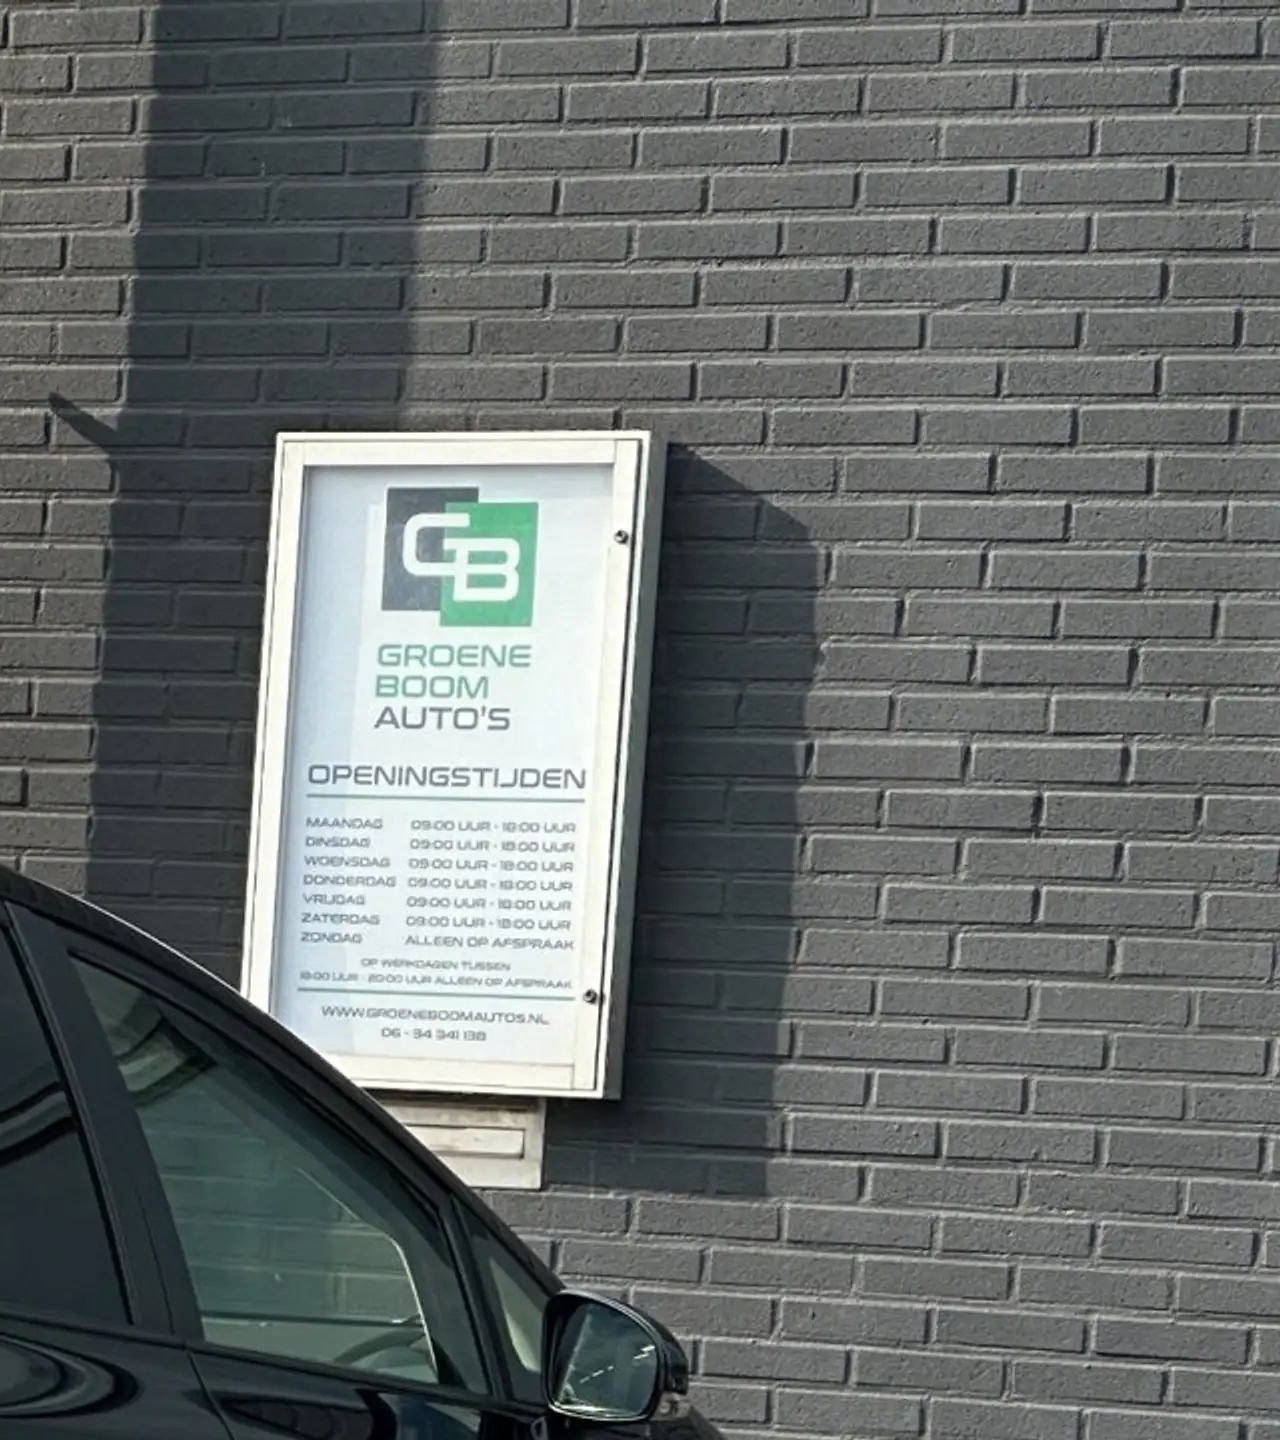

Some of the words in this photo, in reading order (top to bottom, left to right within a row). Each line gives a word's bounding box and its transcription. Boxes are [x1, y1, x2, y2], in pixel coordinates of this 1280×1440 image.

[377, 643, 533, 668] GROENE
[374, 674, 489, 699] BOOM
[374, 705, 511, 730] AUTO'S
[307, 764, 587, 789] OPENINGSTIJDEN
[305, 817, 384, 830] MAANDAG
[458, 821, 490, 832] UUR
[544, 822, 576, 833] UUR
[305, 836, 371, 848] DINSDAG
[457, 839, 490, 851] UUR
[542, 841, 575, 852] UUR
[304, 856, 391, 868] WOENSDAG
[456, 859, 489, 870] UUR
[541, 861, 573, 872] UUR
[303, 874, 397, 887] DONDERDAG
[454, 878, 488, 890] UUR
[540, 880, 573, 891] UUR
[302, 893, 366, 905] VRIJDAG
[453, 897, 486, 908] UUR
[540, 899, 571, 911] UUR
[301, 912, 380, 925] ZATERDAG
[452, 916, 485, 928] UUR
[538, 919, 571, 930] UUR
[301, 931, 362, 944] ZONDAG
[404, 935, 463, 947] ALLEEN
[466, 936, 488, 947] OP
[492, 938, 574, 950] AFSPRAAK
